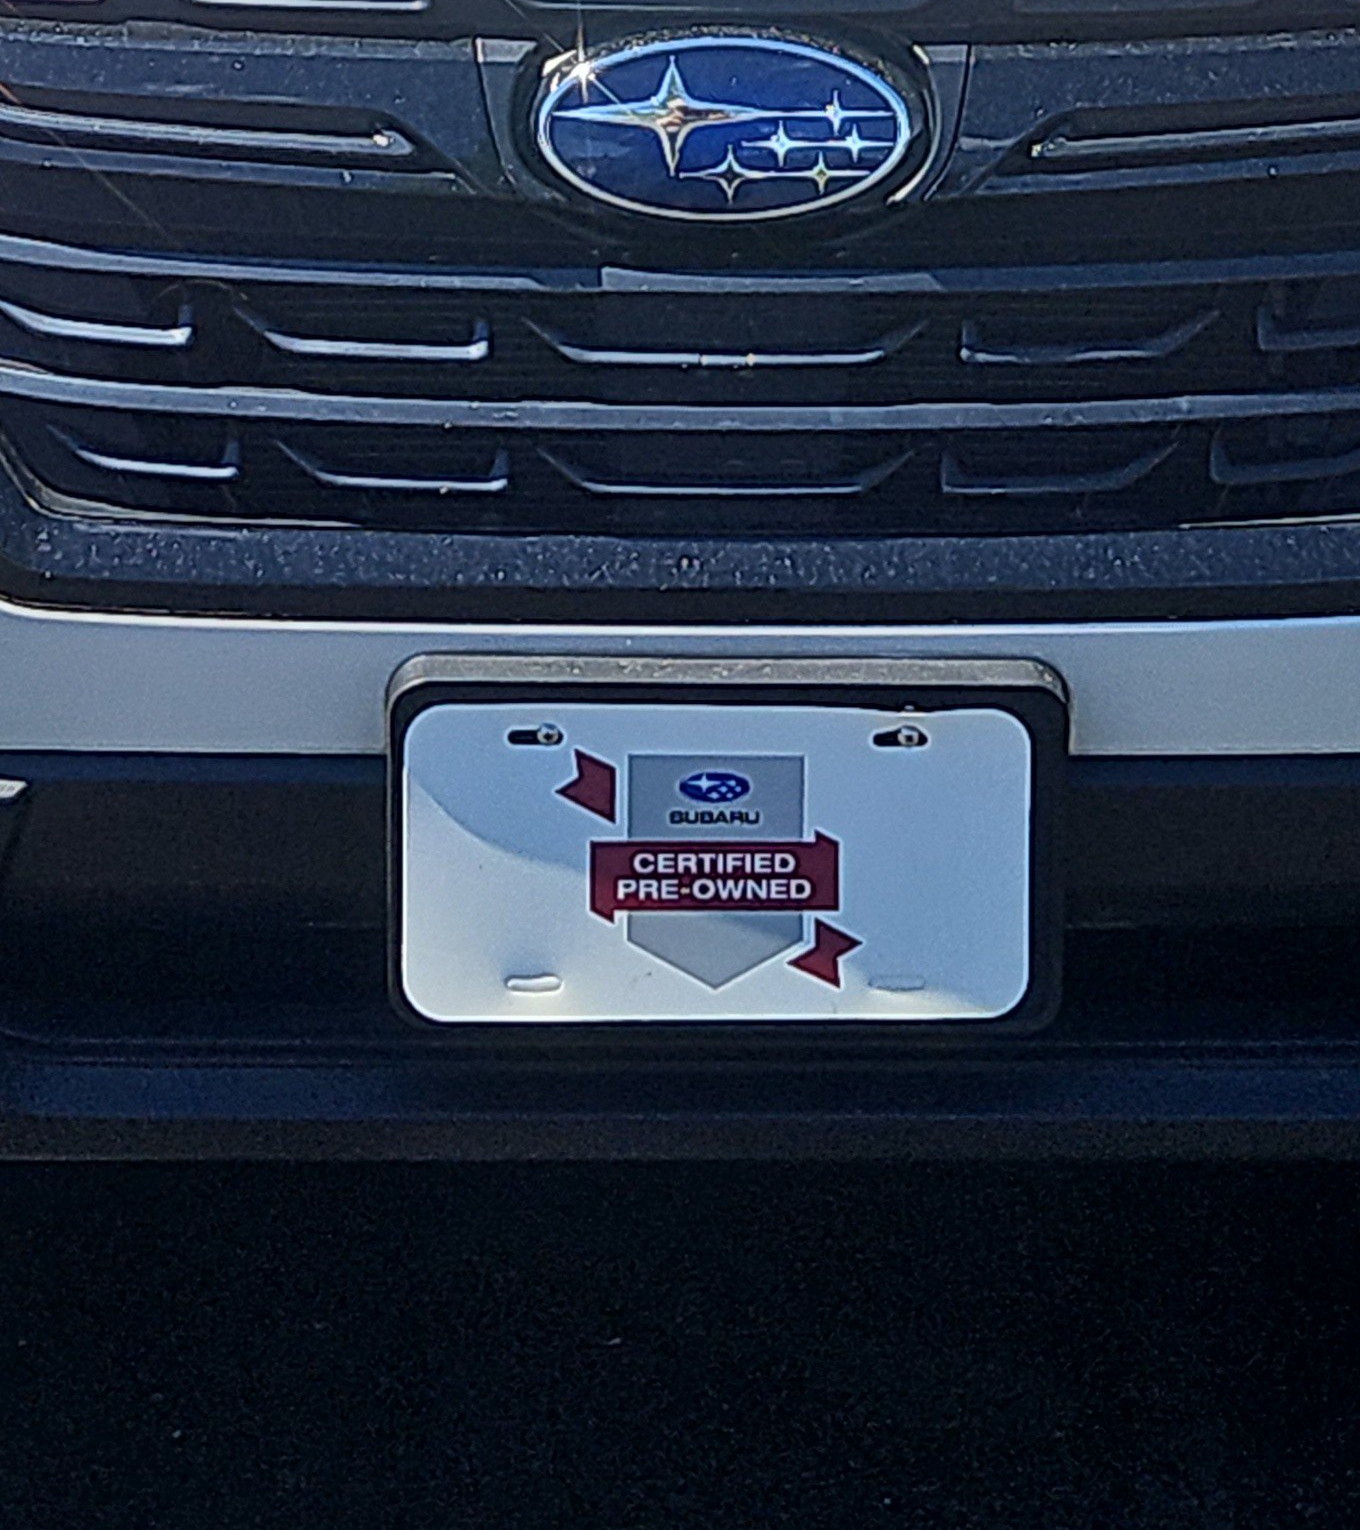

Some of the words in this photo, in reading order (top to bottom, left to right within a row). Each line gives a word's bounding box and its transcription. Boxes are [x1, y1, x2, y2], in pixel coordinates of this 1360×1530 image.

[670, 810, 761, 825] SUBARU
[633, 852, 796, 874] CERTIFIED
[616, 878, 812, 901] PRE-OWNED
